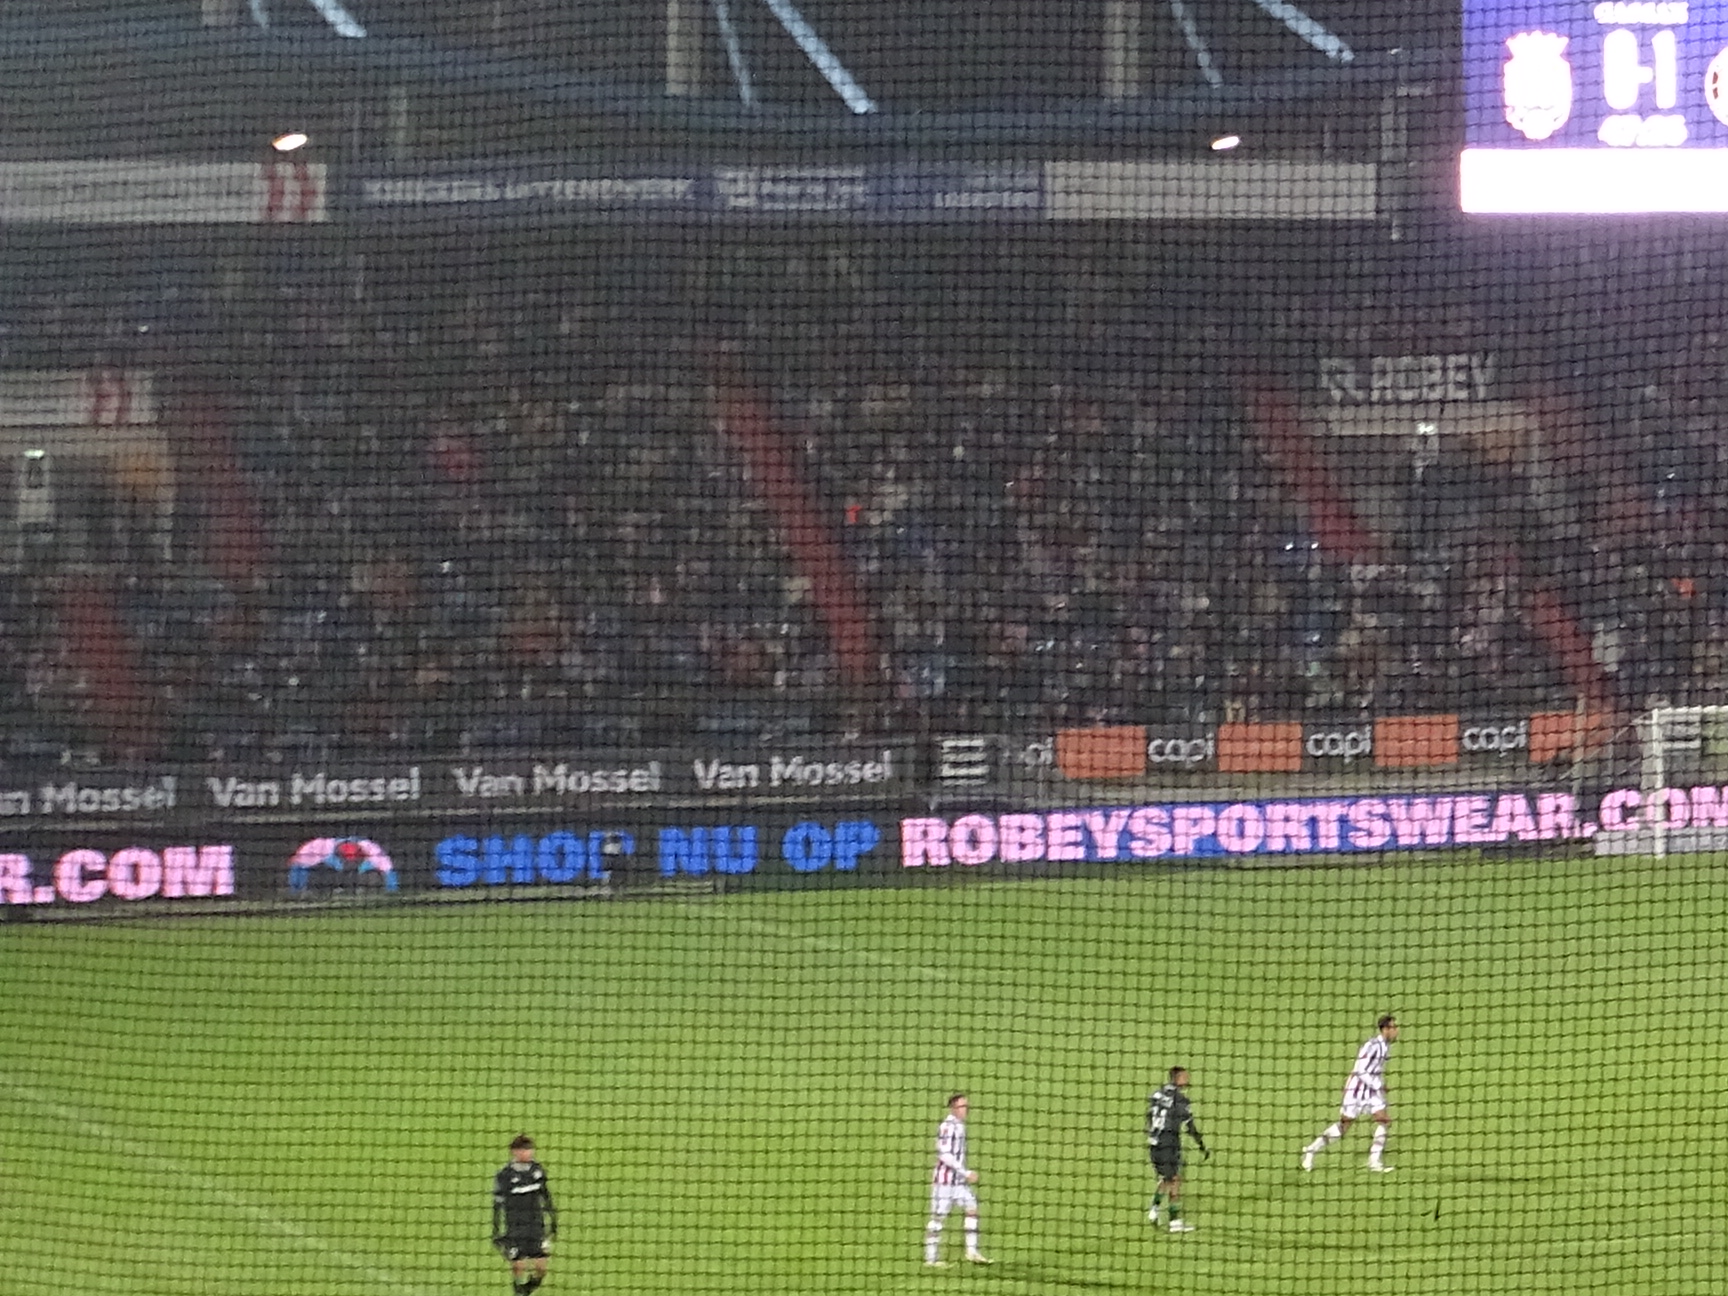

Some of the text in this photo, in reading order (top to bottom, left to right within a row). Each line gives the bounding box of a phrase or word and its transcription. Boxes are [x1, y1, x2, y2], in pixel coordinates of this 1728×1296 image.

[1148, 732, 1215, 766] capi
[1306, 725, 1372, 762] capi
[1463, 720, 1527, 757] capi
[206, 767, 421, 808] Van Mossel
[452, 760, 660, 797] Van Mossel
[693, 750, 893, 790] Van Mossel
[40, 775, 177, 814] Mossel
[659, 824, 758, 877] NU
[782, 819, 882, 872] OP
